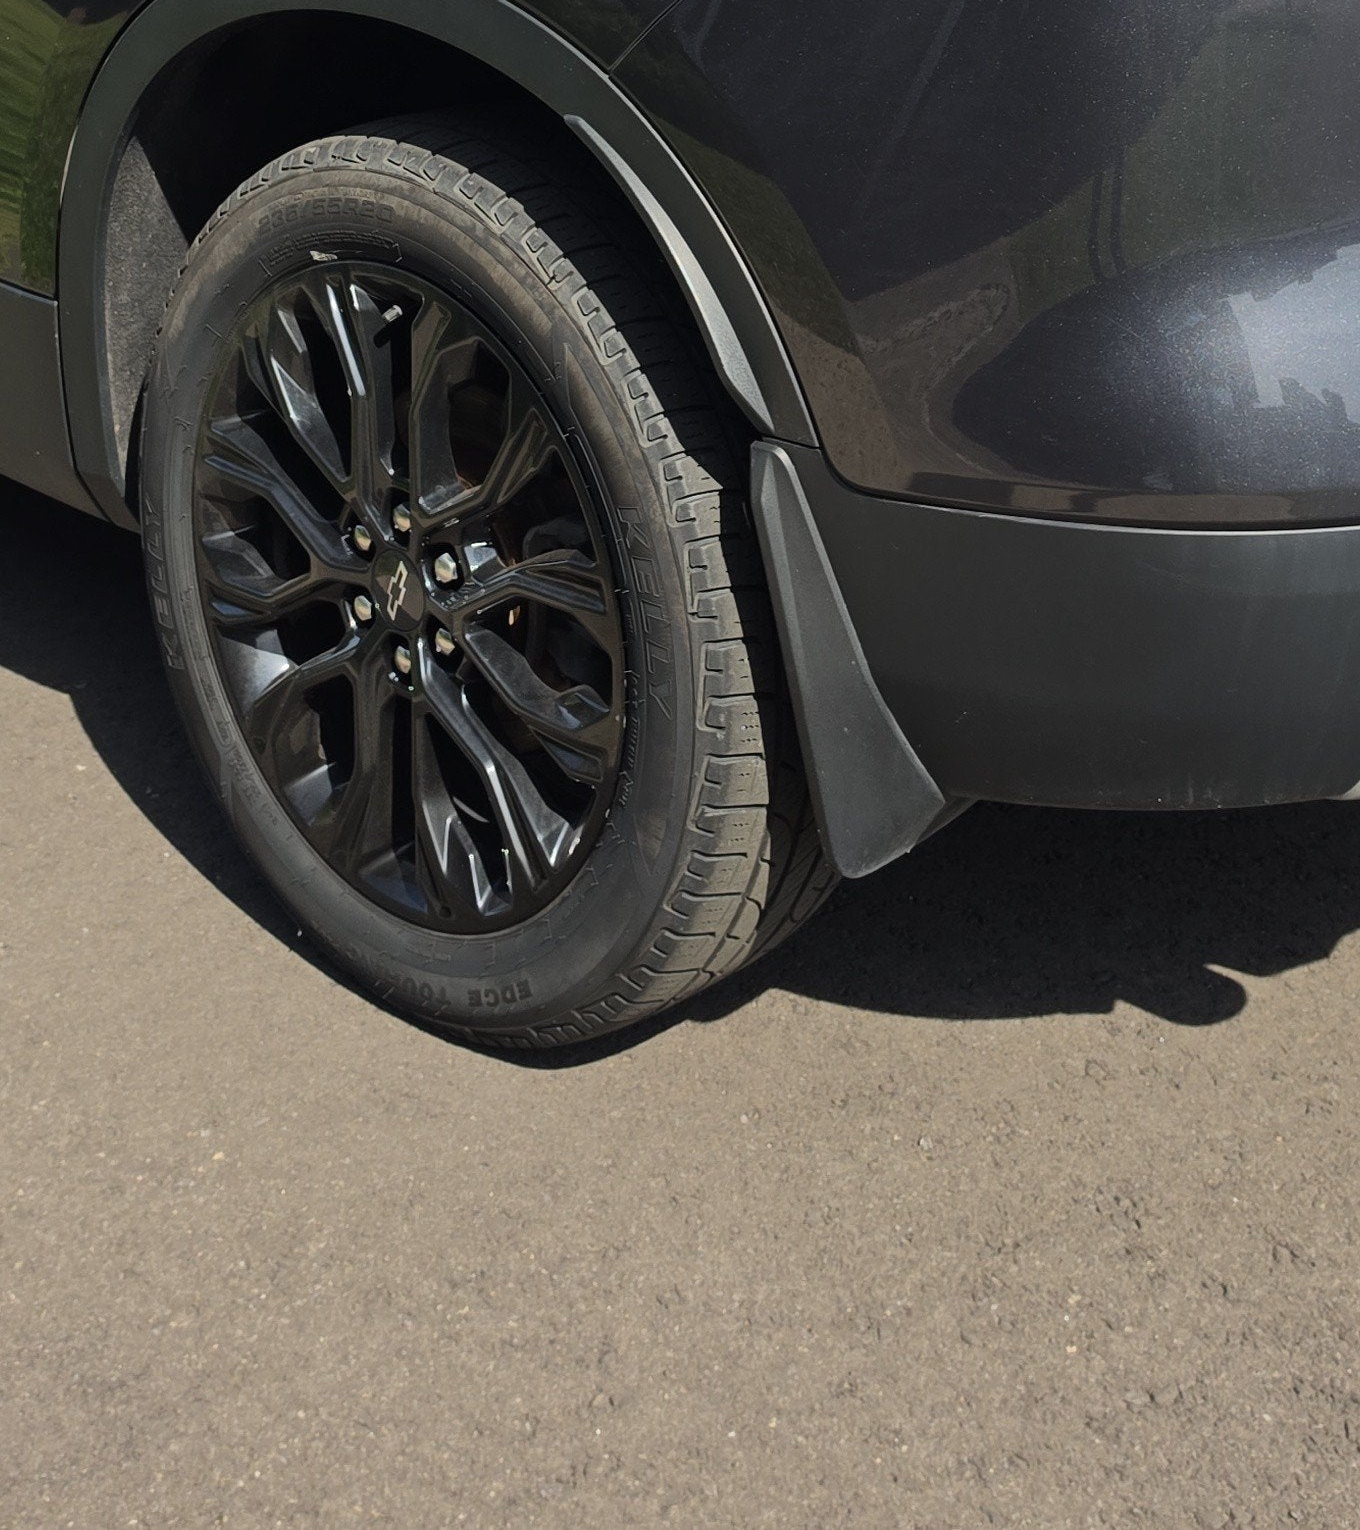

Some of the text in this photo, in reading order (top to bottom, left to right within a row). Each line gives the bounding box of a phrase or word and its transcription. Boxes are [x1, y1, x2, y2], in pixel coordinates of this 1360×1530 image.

[144, 491, 186, 672] KELLY
[616, 506, 675, 721] KELLY
[466, 978, 534, 1010] EDGE
